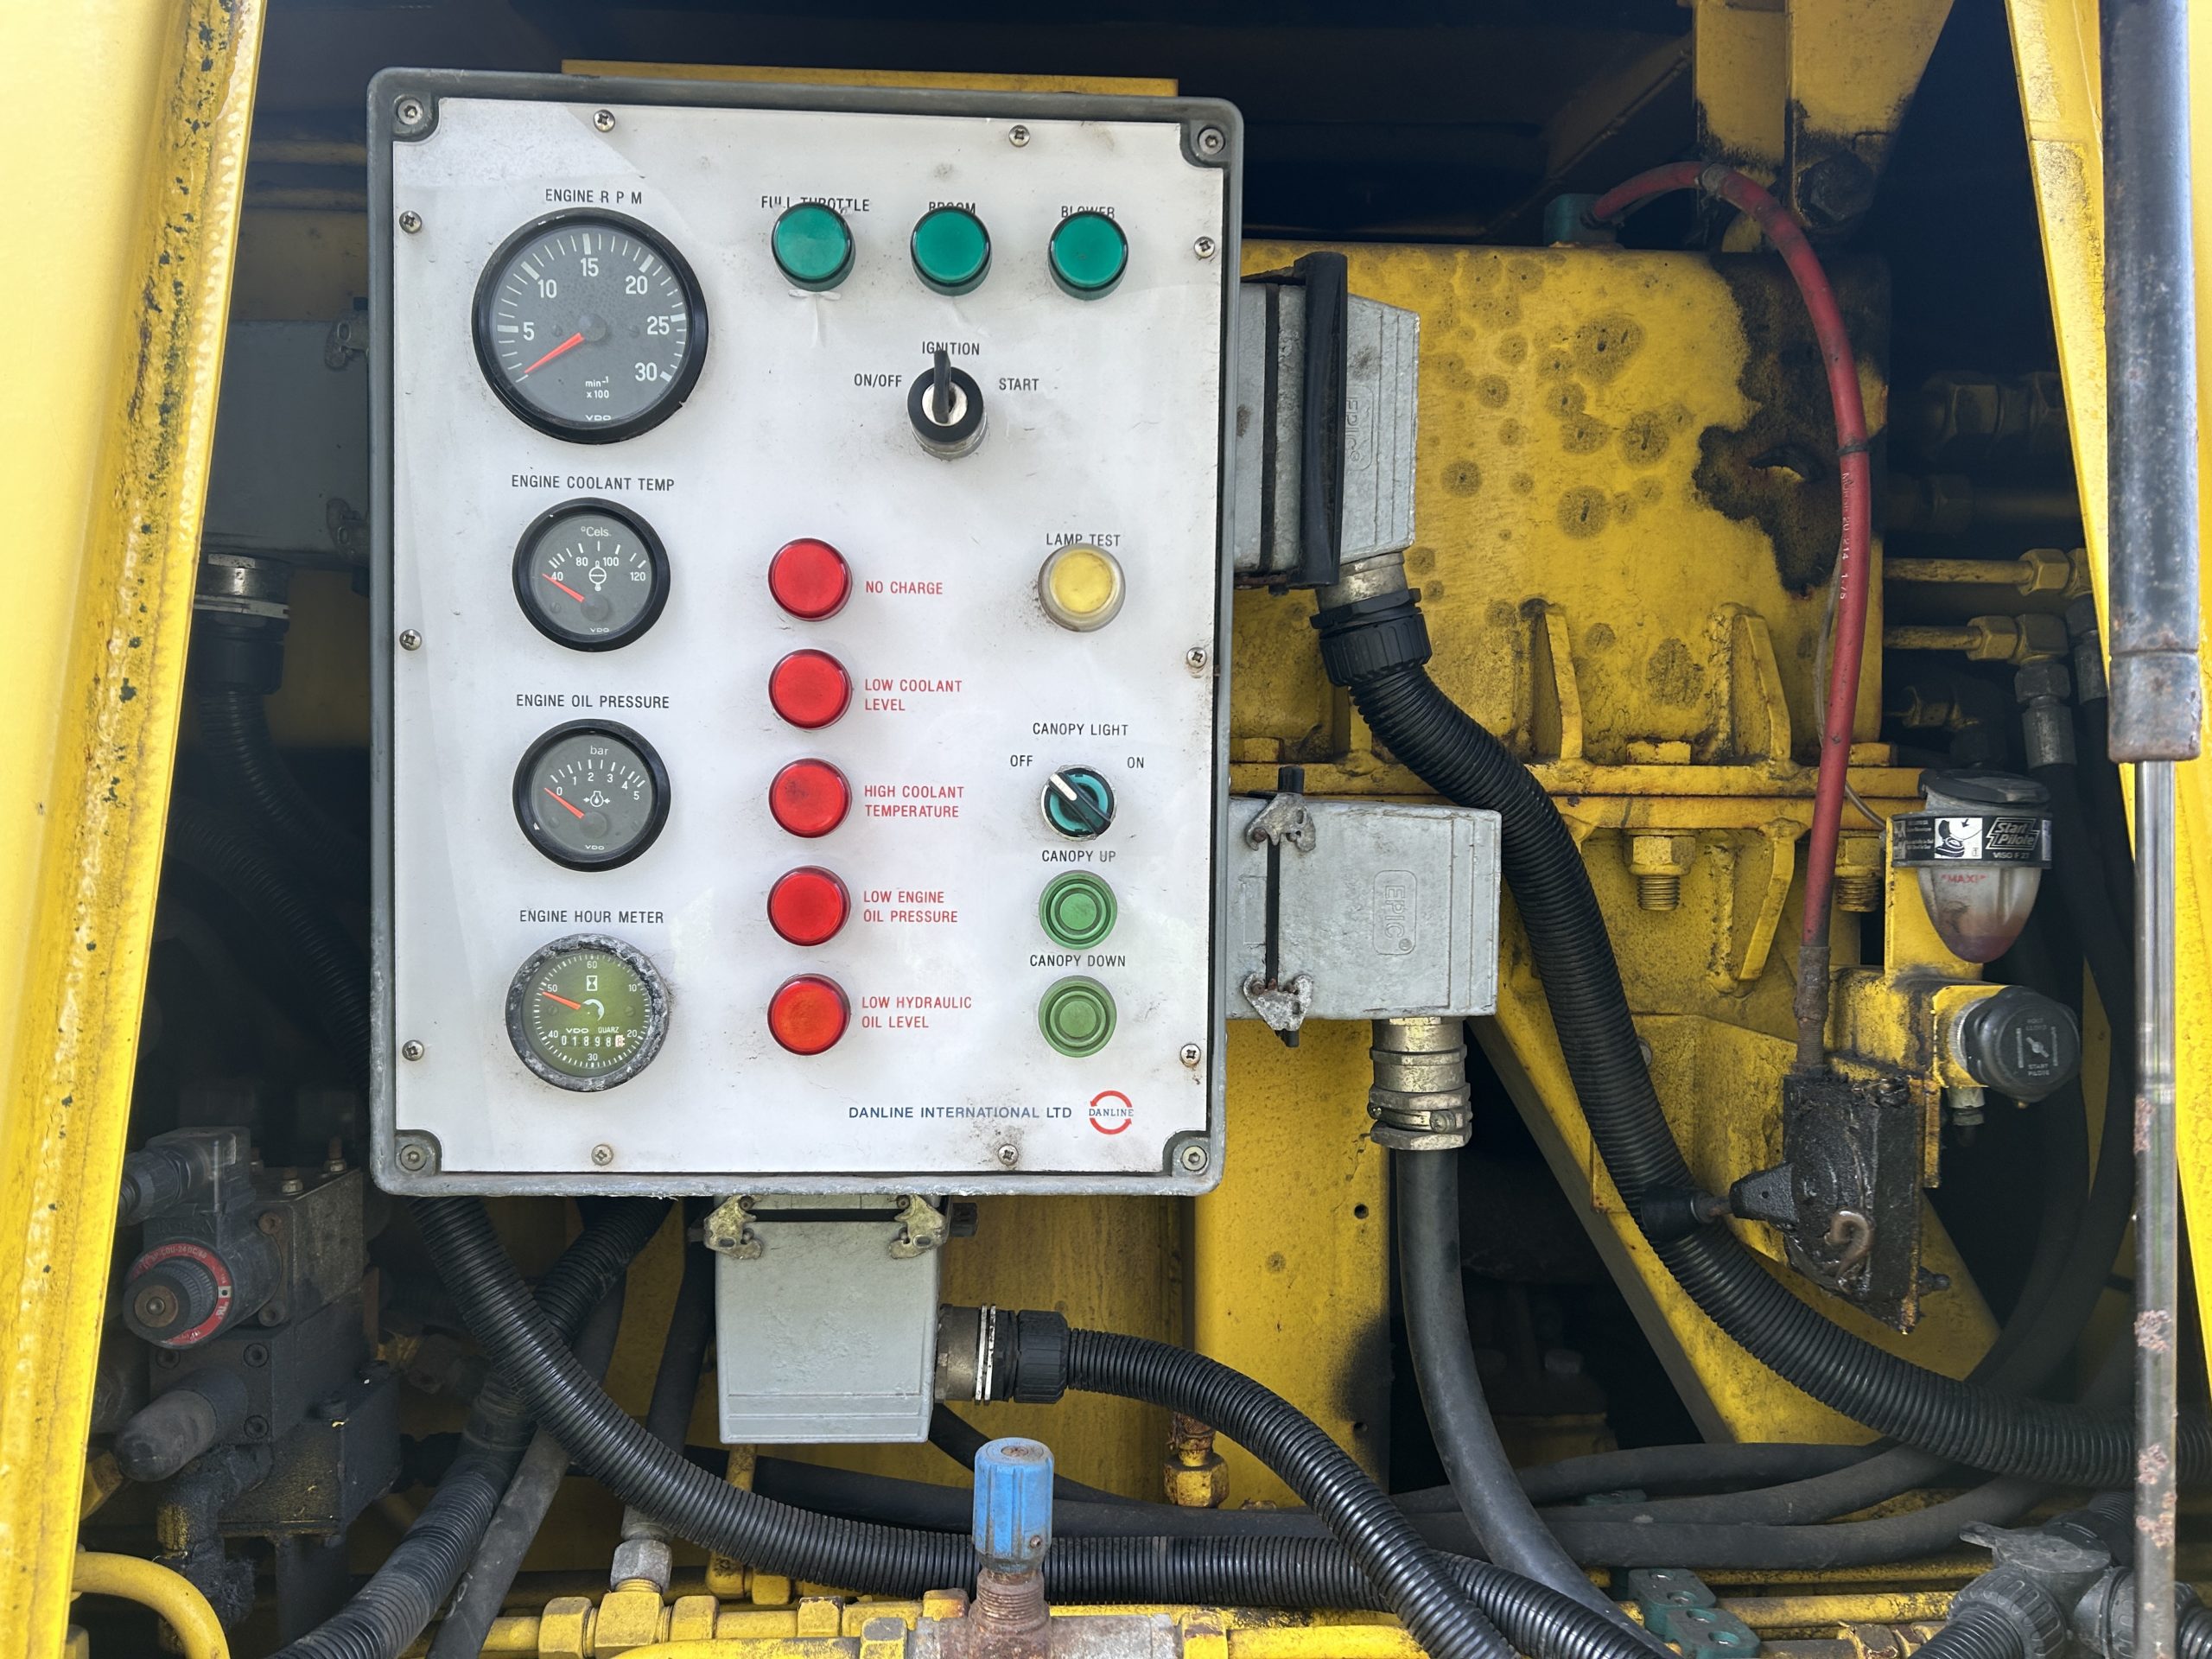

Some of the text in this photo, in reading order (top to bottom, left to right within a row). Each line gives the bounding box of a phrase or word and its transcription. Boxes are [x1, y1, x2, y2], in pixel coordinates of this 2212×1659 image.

[545, 188, 642, 205] ENGINE R P M
[580, 257, 599, 276] 15
[538, 279, 557, 298] 10
[625, 276, 648, 295] 20
[523, 321, 535, 340] 5
[646, 315, 670, 335] 25
[634, 362, 658, 381] 30
[854, 373, 902, 388] ON/OFF
[998, 378, 1039, 391] START
[594, 390, 609, 398] 100
[512, 474, 675, 492] ENGINE COOLANT TEMP
[1046, 533, 1121, 547] LAMP TEST
[575, 557, 588, 567] 80
[602, 557, 620, 567] 100
[551, 571, 564, 582] 40
[630, 571, 646, 582] 120
[866, 581, 944, 594] NO CHARGE
[865, 678, 963, 692] LOW COOLANT
[516, 694, 670, 709] ENGINE OIL PRESSURE
[865, 698, 906, 711] LEVEL
[1033, 722, 1128, 736] CANOPY LIGHT
[590, 745, 609, 756] bar
[1010, 754, 1033, 767] OFF
[1127, 756, 1144, 769] ON
[573, 777, 577, 785] 1
[588, 772, 594, 782] 2
[607, 773, 613, 783] 3
[556, 786, 563, 796] 0
[621, 780, 628, 790] 4
[864, 785, 964, 798] HIGH COOLANT
[633, 791, 640, 800] 5
[865, 804, 959, 817] TEMPERATURE
[1041, 849, 1116, 862] CANOPY UP
[864, 890, 944, 904] LOW ENGINE
[519, 910, 664, 924] ENGINE HOUR METER
[863, 909, 958, 923] OIL PRESSURE
[1384, 885, 1406, 938] EPIC
[1030, 954, 1126, 968] CANOPY DOWN
[547, 983, 558, 992] 50
[628, 983, 638, 992] 10
[861, 996, 972, 1009] LOW HYDRAULIC
[861, 1015, 929, 1028] OIL LEVEL
[548, 1029, 559, 1039] 40
[626, 1029, 638, 1038] 20
[588, 1052, 599, 1061] 30
[849, 1106, 1072, 1119] DANLINE INTERNATIONAL LTD
[1088, 1108, 1135, 1117] DANLINE
